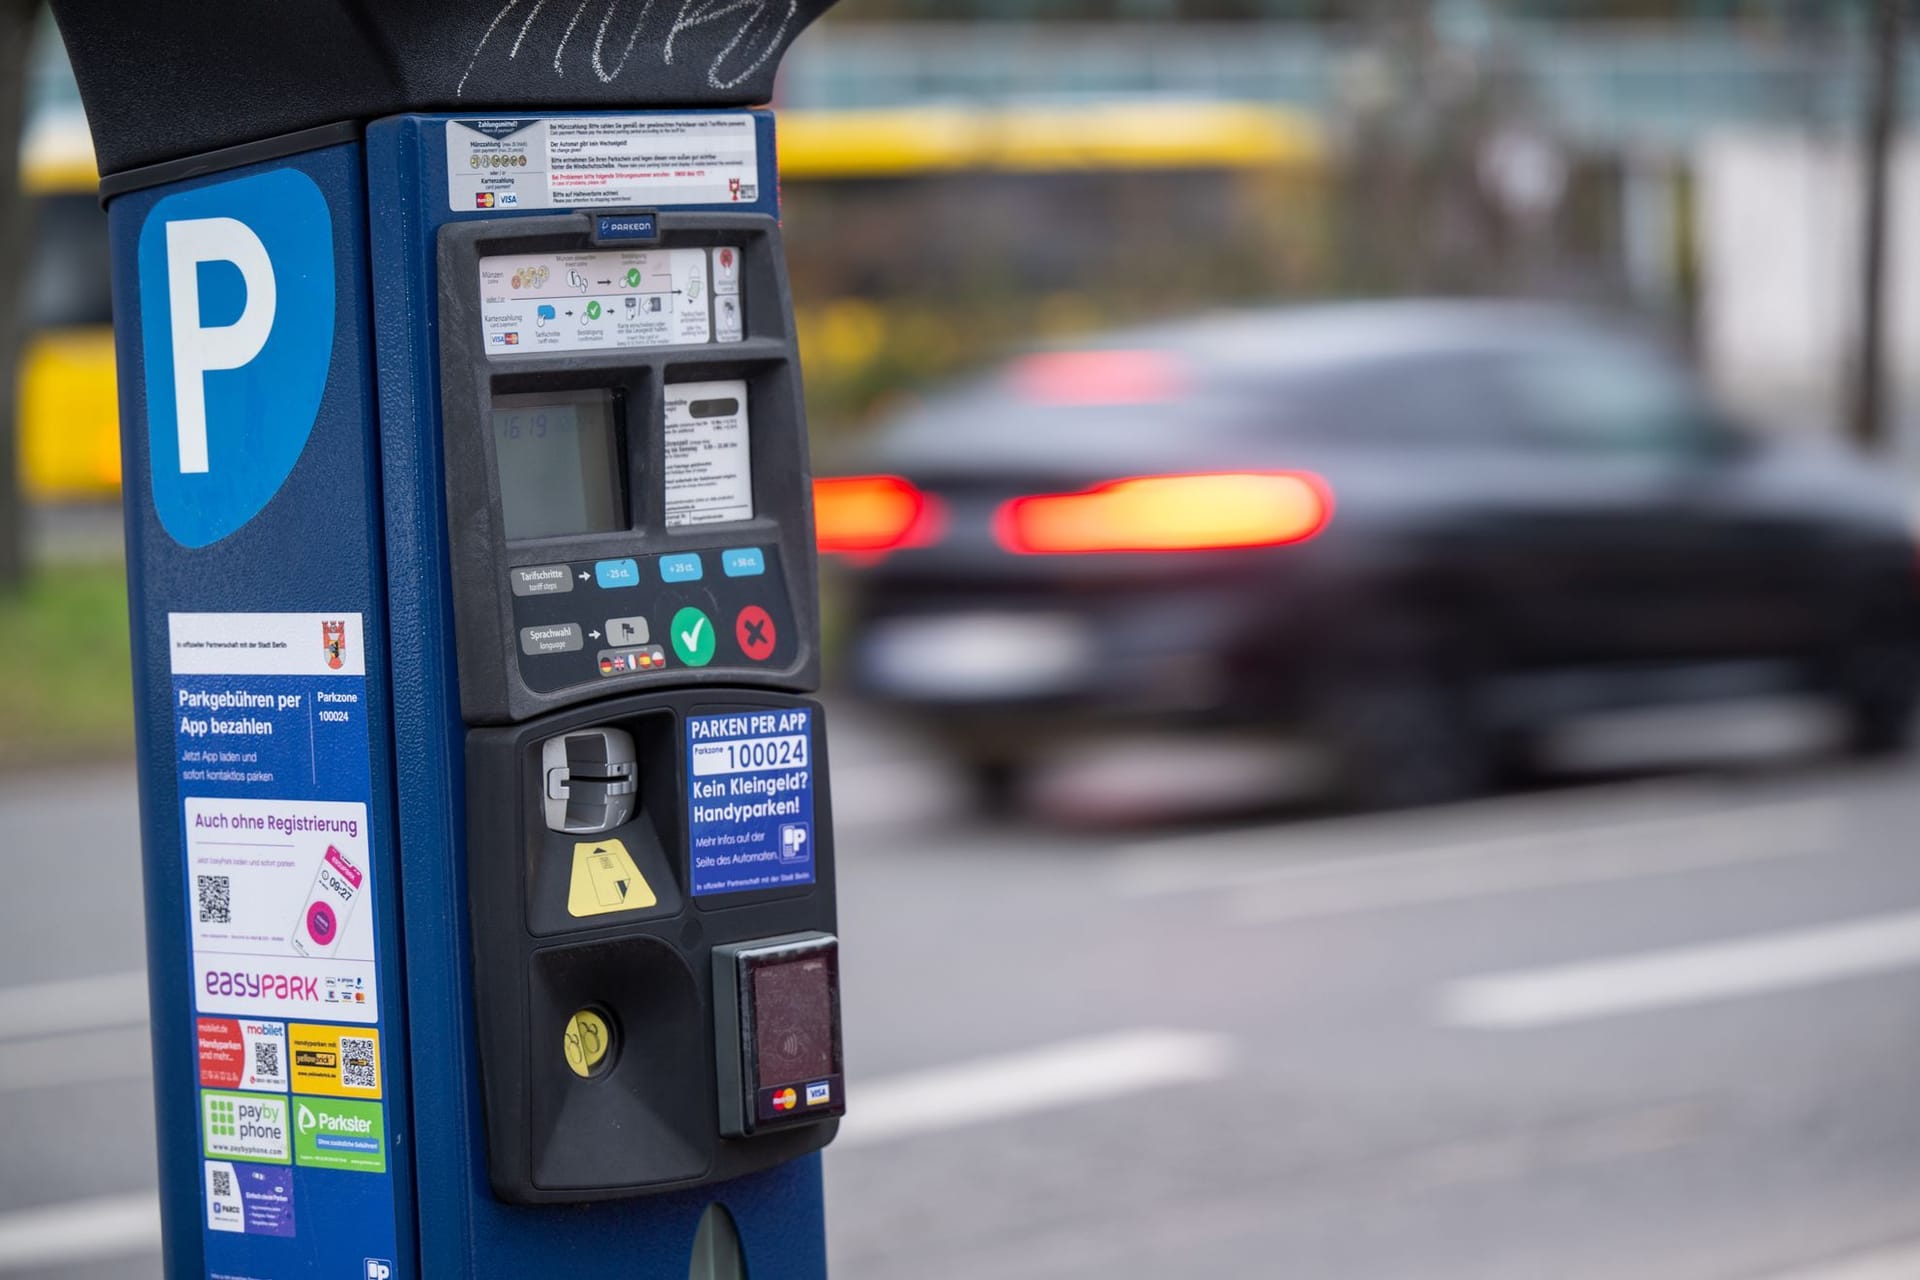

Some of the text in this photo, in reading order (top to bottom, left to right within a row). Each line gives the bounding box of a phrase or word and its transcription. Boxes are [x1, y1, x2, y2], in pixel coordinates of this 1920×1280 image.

[611, 222, 651, 231] PARKEON
[484, 314, 522, 322] Kartenzahlung
[166, 217, 276, 473] P
[520, 569, 563, 581] Tarifschritte
[529, 583, 543, 591] tariff
[530, 626, 572, 641] Sprachwahl
[540, 641, 566, 650] language
[179, 690, 301, 711] Parkgebühren per
[317, 692, 357, 704] Parkzone
[319, 711, 349, 722] 100024
[180, 717, 272, 737] App bezahlen
[692, 713, 806, 739] PARKEN PER APP
[182, 750, 257, 763] Jetzt App laden und
[694, 738, 804, 768] Parkzone 100024
[183, 770, 273, 782] sofort kontaktlos parken
[693, 772, 808, 799] Kein Kleingeld?
[694, 796, 800, 823] Handyparken!
[195, 814, 357, 838] Auch ohne Registrierung
[696, 831, 765, 848] Mehr Infos auf der
[696, 851, 779, 868] Seite des Automaten.
[329, 877, 352, 901] 09:27
[247, 1024, 283, 1036] mobilet
[811, 1089, 826, 1098] VISA
[239, 1104, 280, 1122] payby
[240, 1123, 281, 1140] phone
[319, 1113, 372, 1133] Parkster
